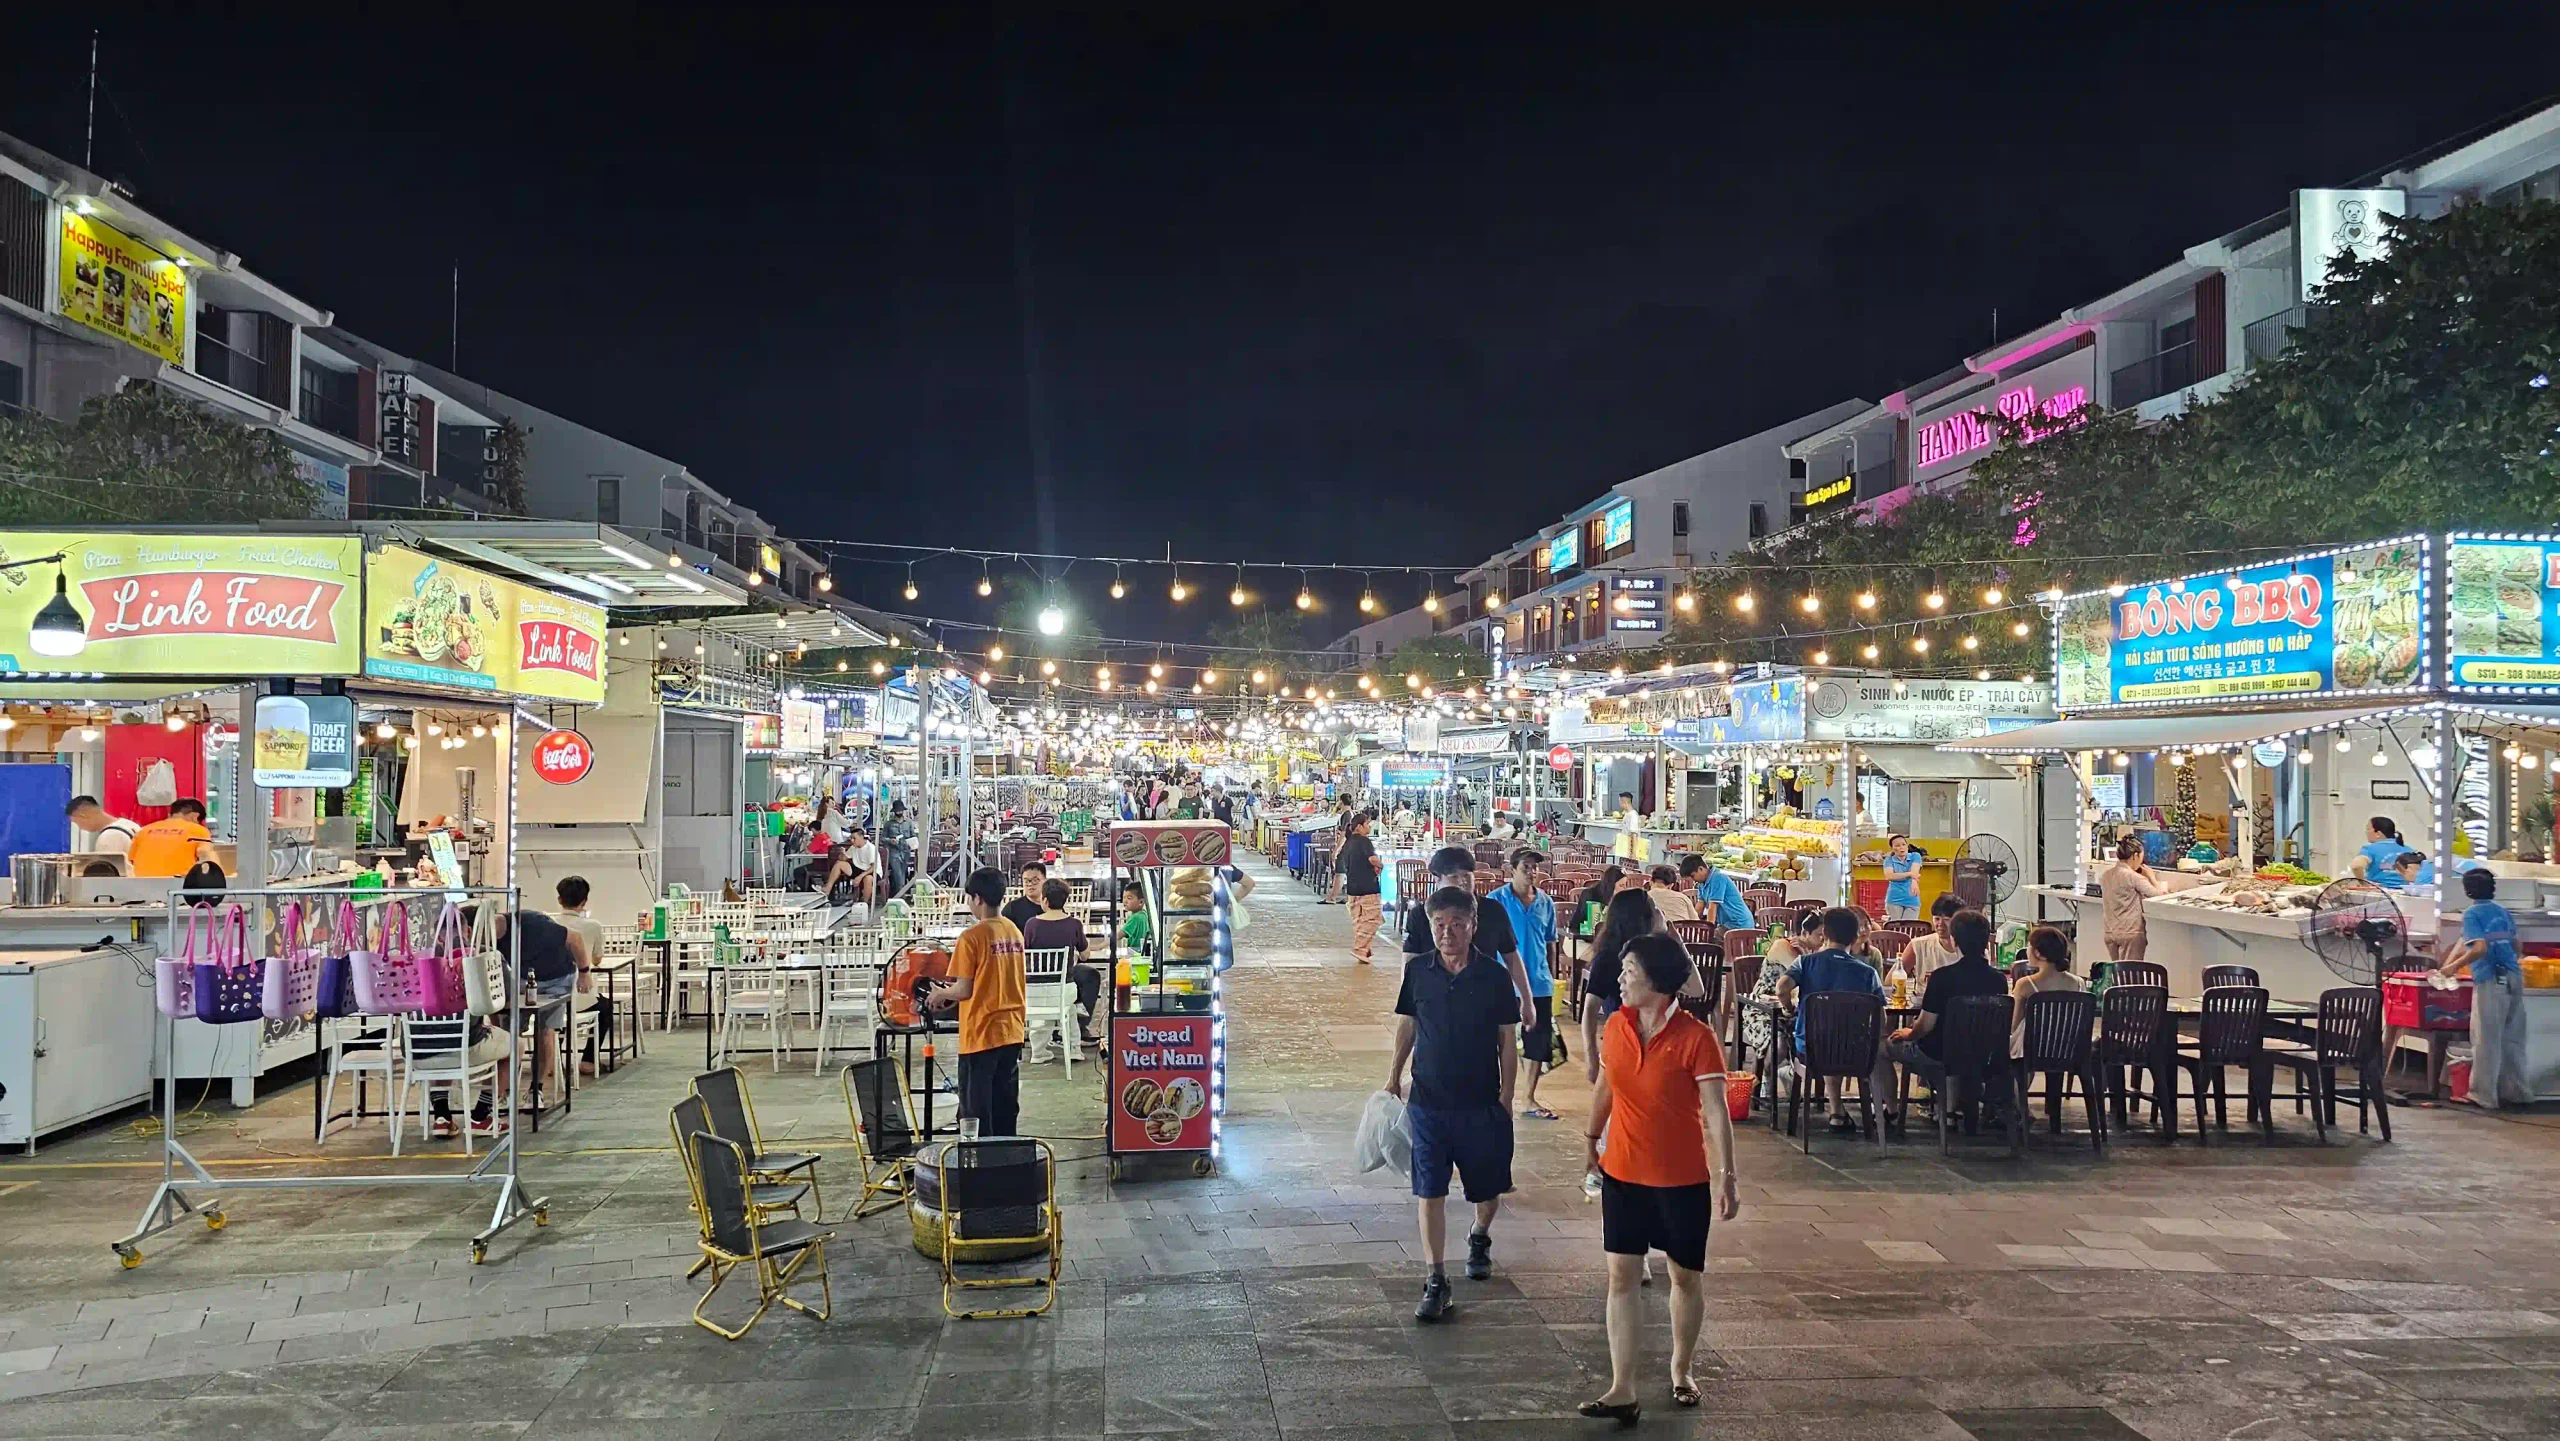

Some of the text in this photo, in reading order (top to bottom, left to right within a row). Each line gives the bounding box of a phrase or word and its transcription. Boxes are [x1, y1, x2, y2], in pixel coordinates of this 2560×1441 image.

[65, 222, 185, 297] Happy Family Spa
[1917, 404, 1991, 468] HANNA
[84, 544, 339, 571] Pizza Hamburger Fried Chicken
[104, 577, 323, 633] Link Food
[2119, 574, 2322, 641] BÔNG BBQ
[527, 624, 595, 672] Link Food
[2153, 666, 2181, 682] 신선한
[1860, 688, 1890, 700] SINH
[1921, 685, 1955, 701] NƯỚC
[1987, 688, 2015, 702] TRÁI
[2018, 688, 2042, 703] CÂY
[312, 723, 347, 737] DRAFT
[264, 742, 300, 750] SAPPORO
[311, 737, 346, 753] BEER
[1128, 1025, 1191, 1044] Bread
[1121, 1049, 1204, 1067] Viet Nam
